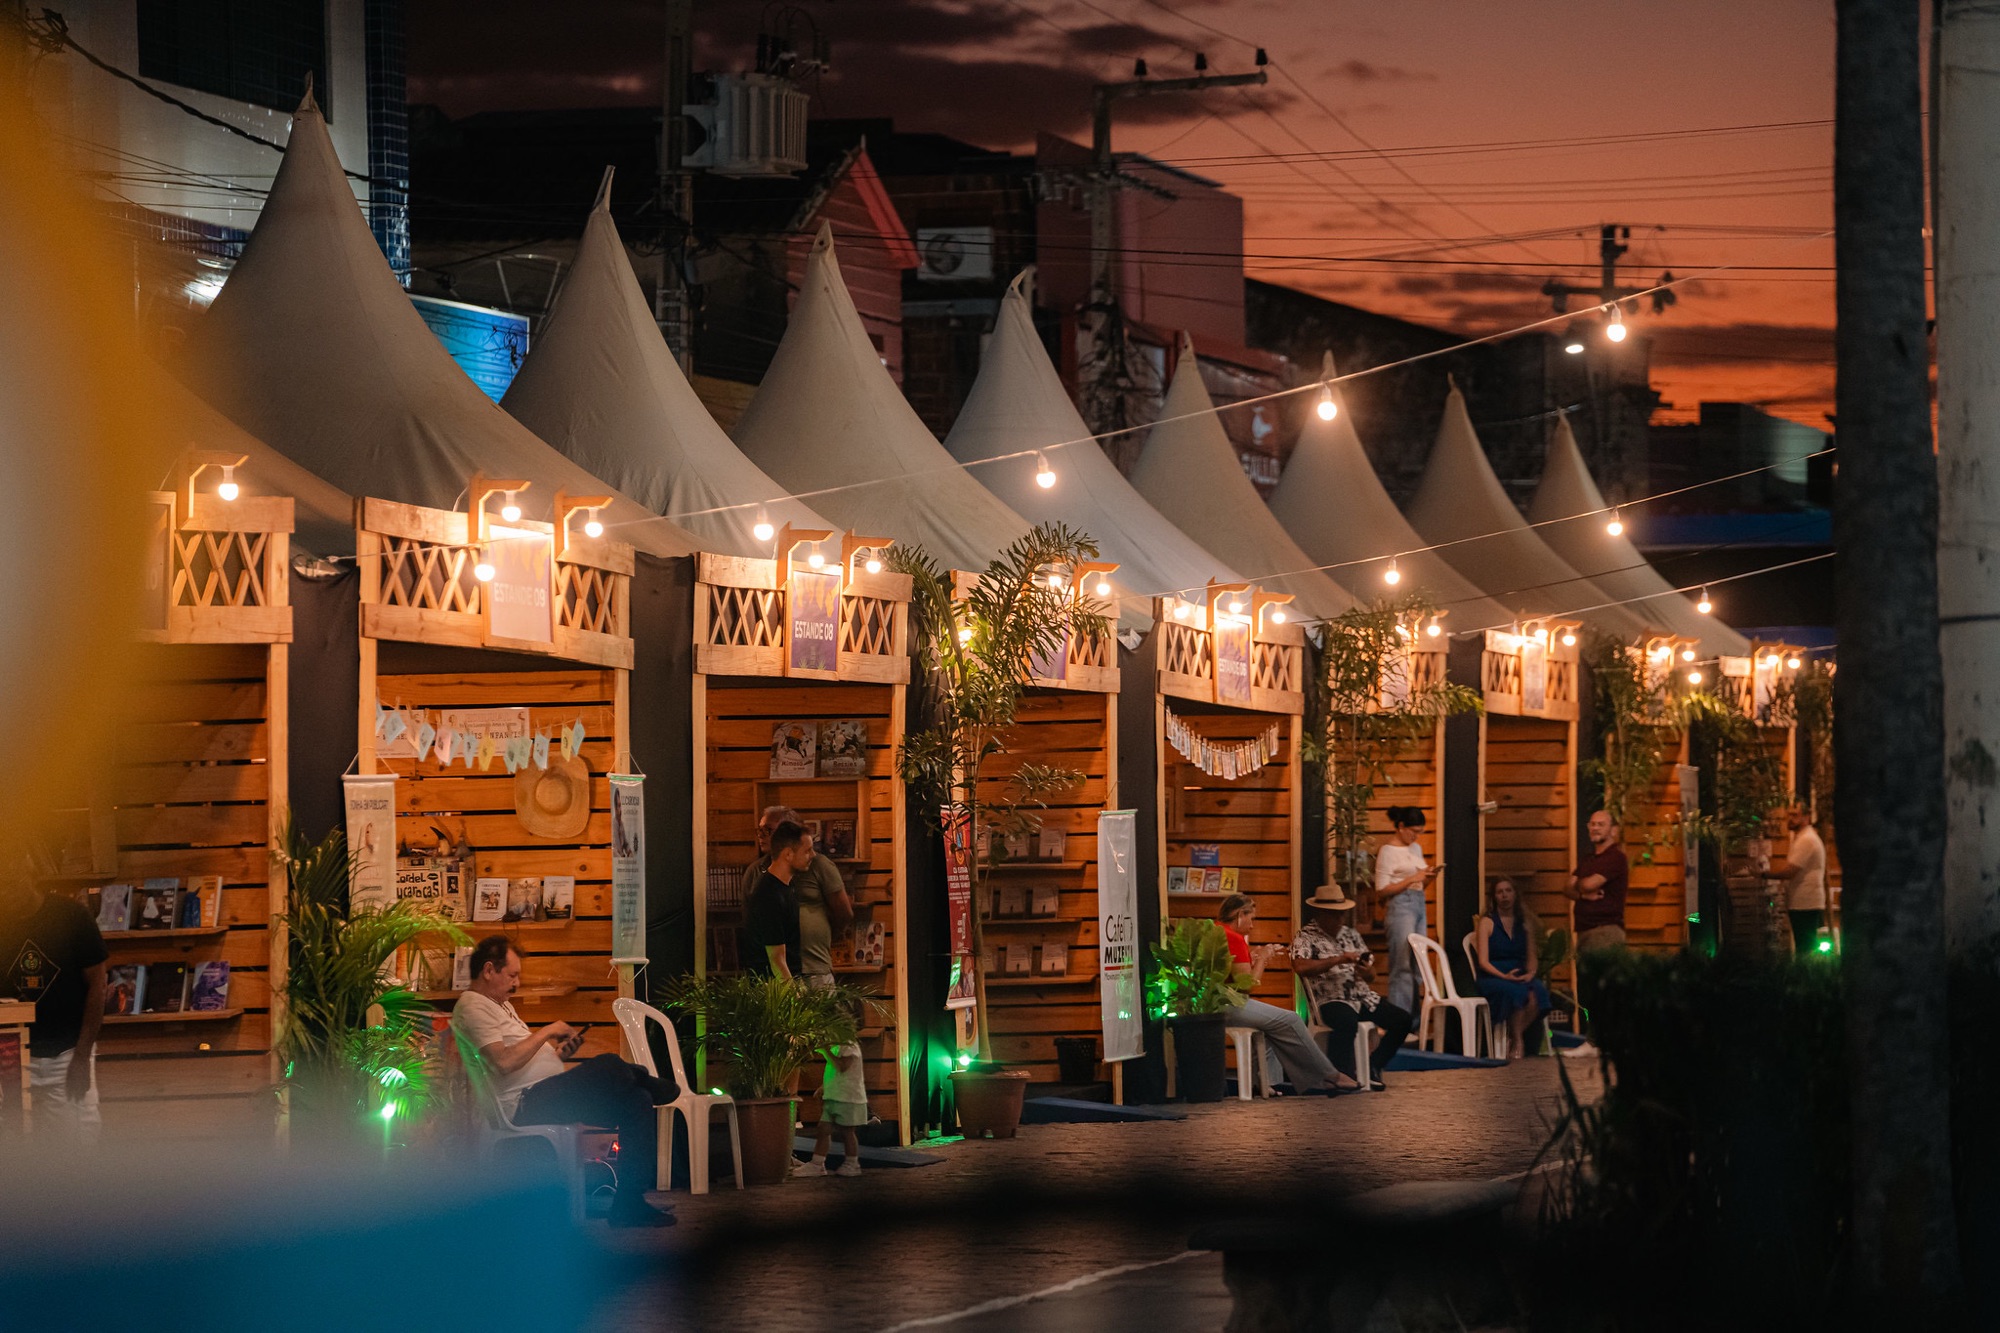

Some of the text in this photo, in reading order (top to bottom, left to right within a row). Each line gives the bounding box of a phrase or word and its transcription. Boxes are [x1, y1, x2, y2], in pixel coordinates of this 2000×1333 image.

[494, 582, 546, 608] ESTANDE 09
[794, 620, 834, 642] ESTANDE 08
[1218, 657, 1240, 676] ESTANDE
